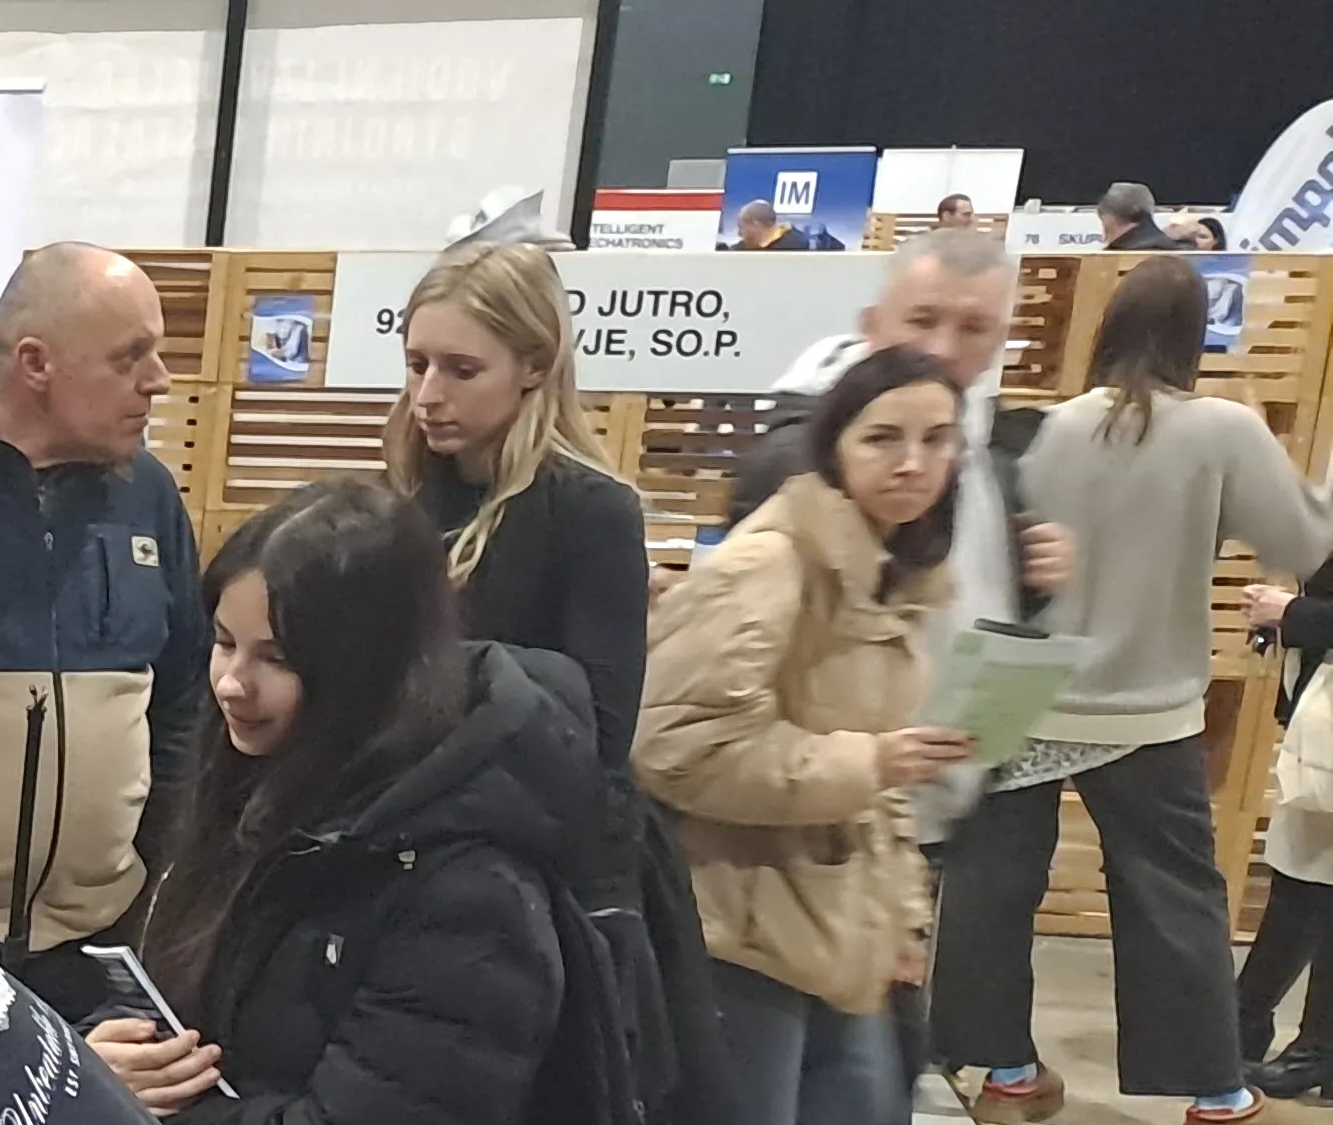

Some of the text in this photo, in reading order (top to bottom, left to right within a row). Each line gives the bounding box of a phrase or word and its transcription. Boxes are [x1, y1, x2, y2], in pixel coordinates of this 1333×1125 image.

[779, 181, 811, 205] IM
[593, 223, 665, 235] TELLIGENT
[598, 290, 730, 323] JUTRO,
[649, 329, 741, 357] SO.P.
